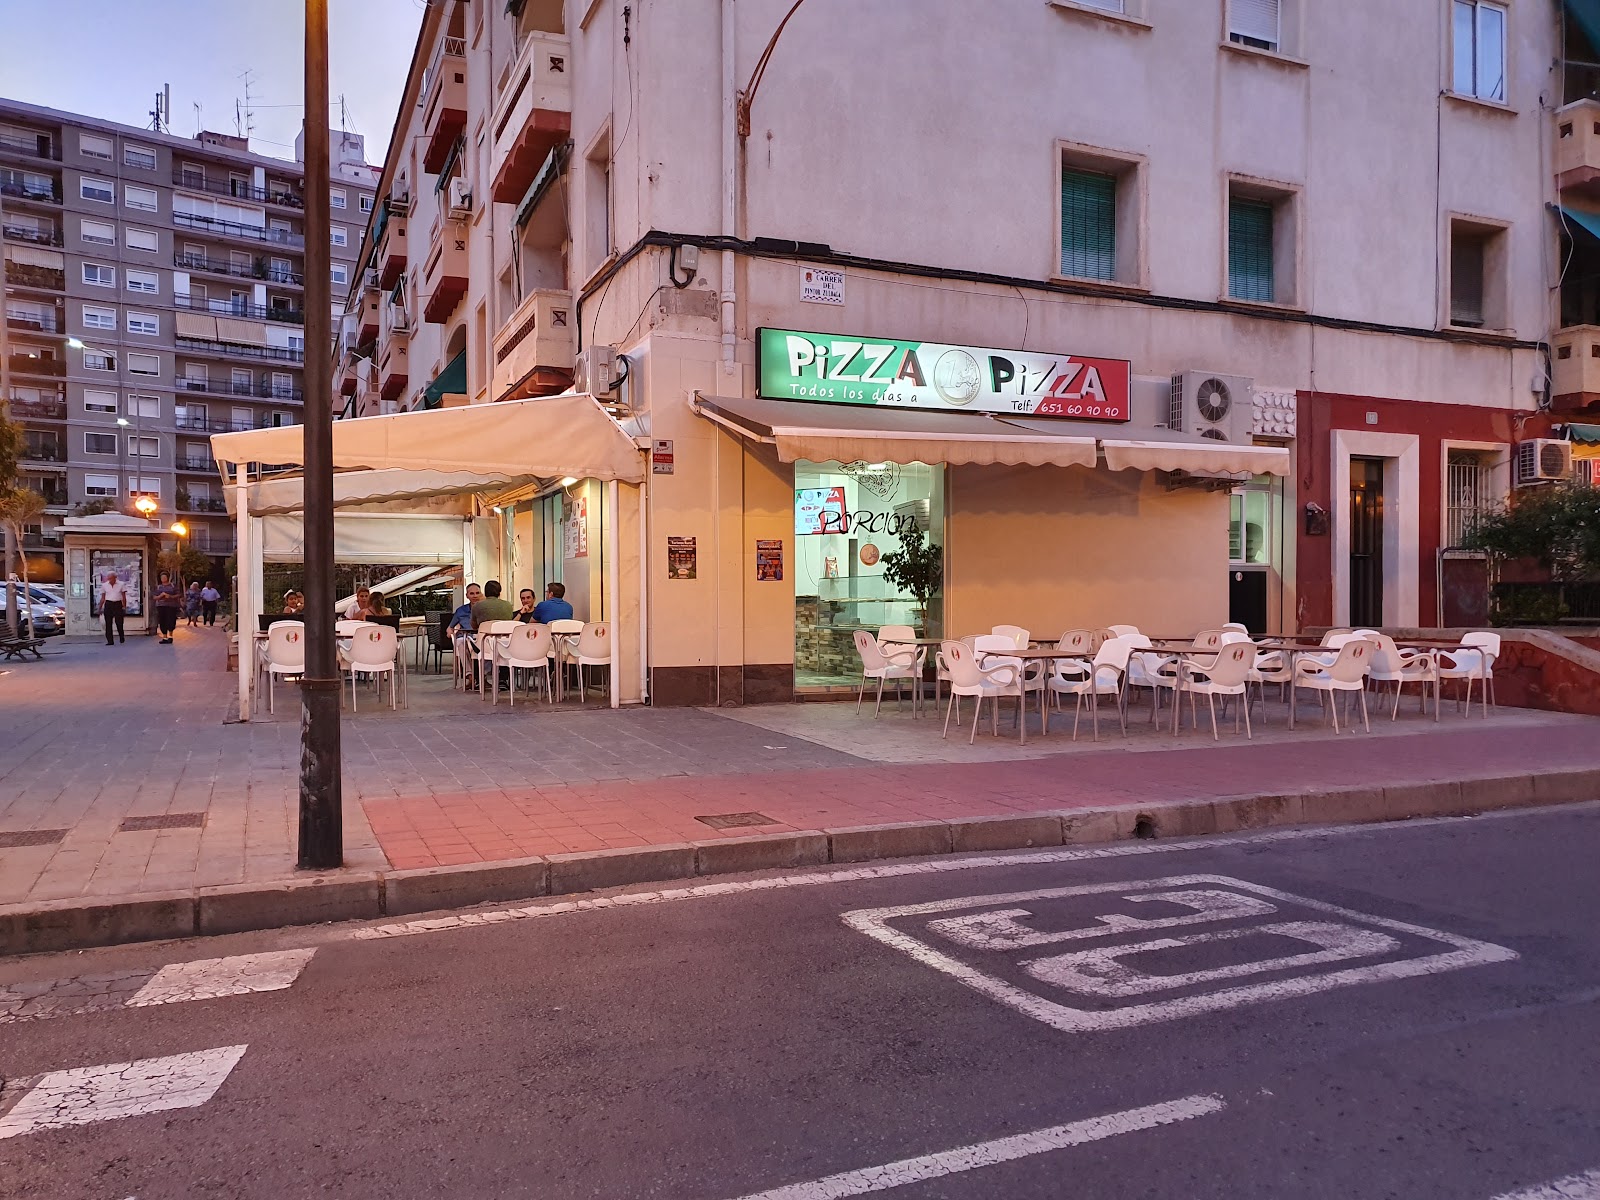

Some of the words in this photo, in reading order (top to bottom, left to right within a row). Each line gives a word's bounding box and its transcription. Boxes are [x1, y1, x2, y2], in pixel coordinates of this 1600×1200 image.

[816, 274, 843, 284] CARRER
[822, 282, 836, 290] DEL
[804, 287, 821, 296] PINTOR
[789, 383, 834, 398] Todos
[843, 385, 864, 399] los
[872, 388, 902, 402] días
[910, 394, 918, 403] a
[1011, 400, 1033, 412] Telf:
[1041, 403, 1064, 413] 651
[1067, 405, 1082, 414] 60
[1086, 406, 1101, 416] 90
[1104, 407, 1119, 417] 90
